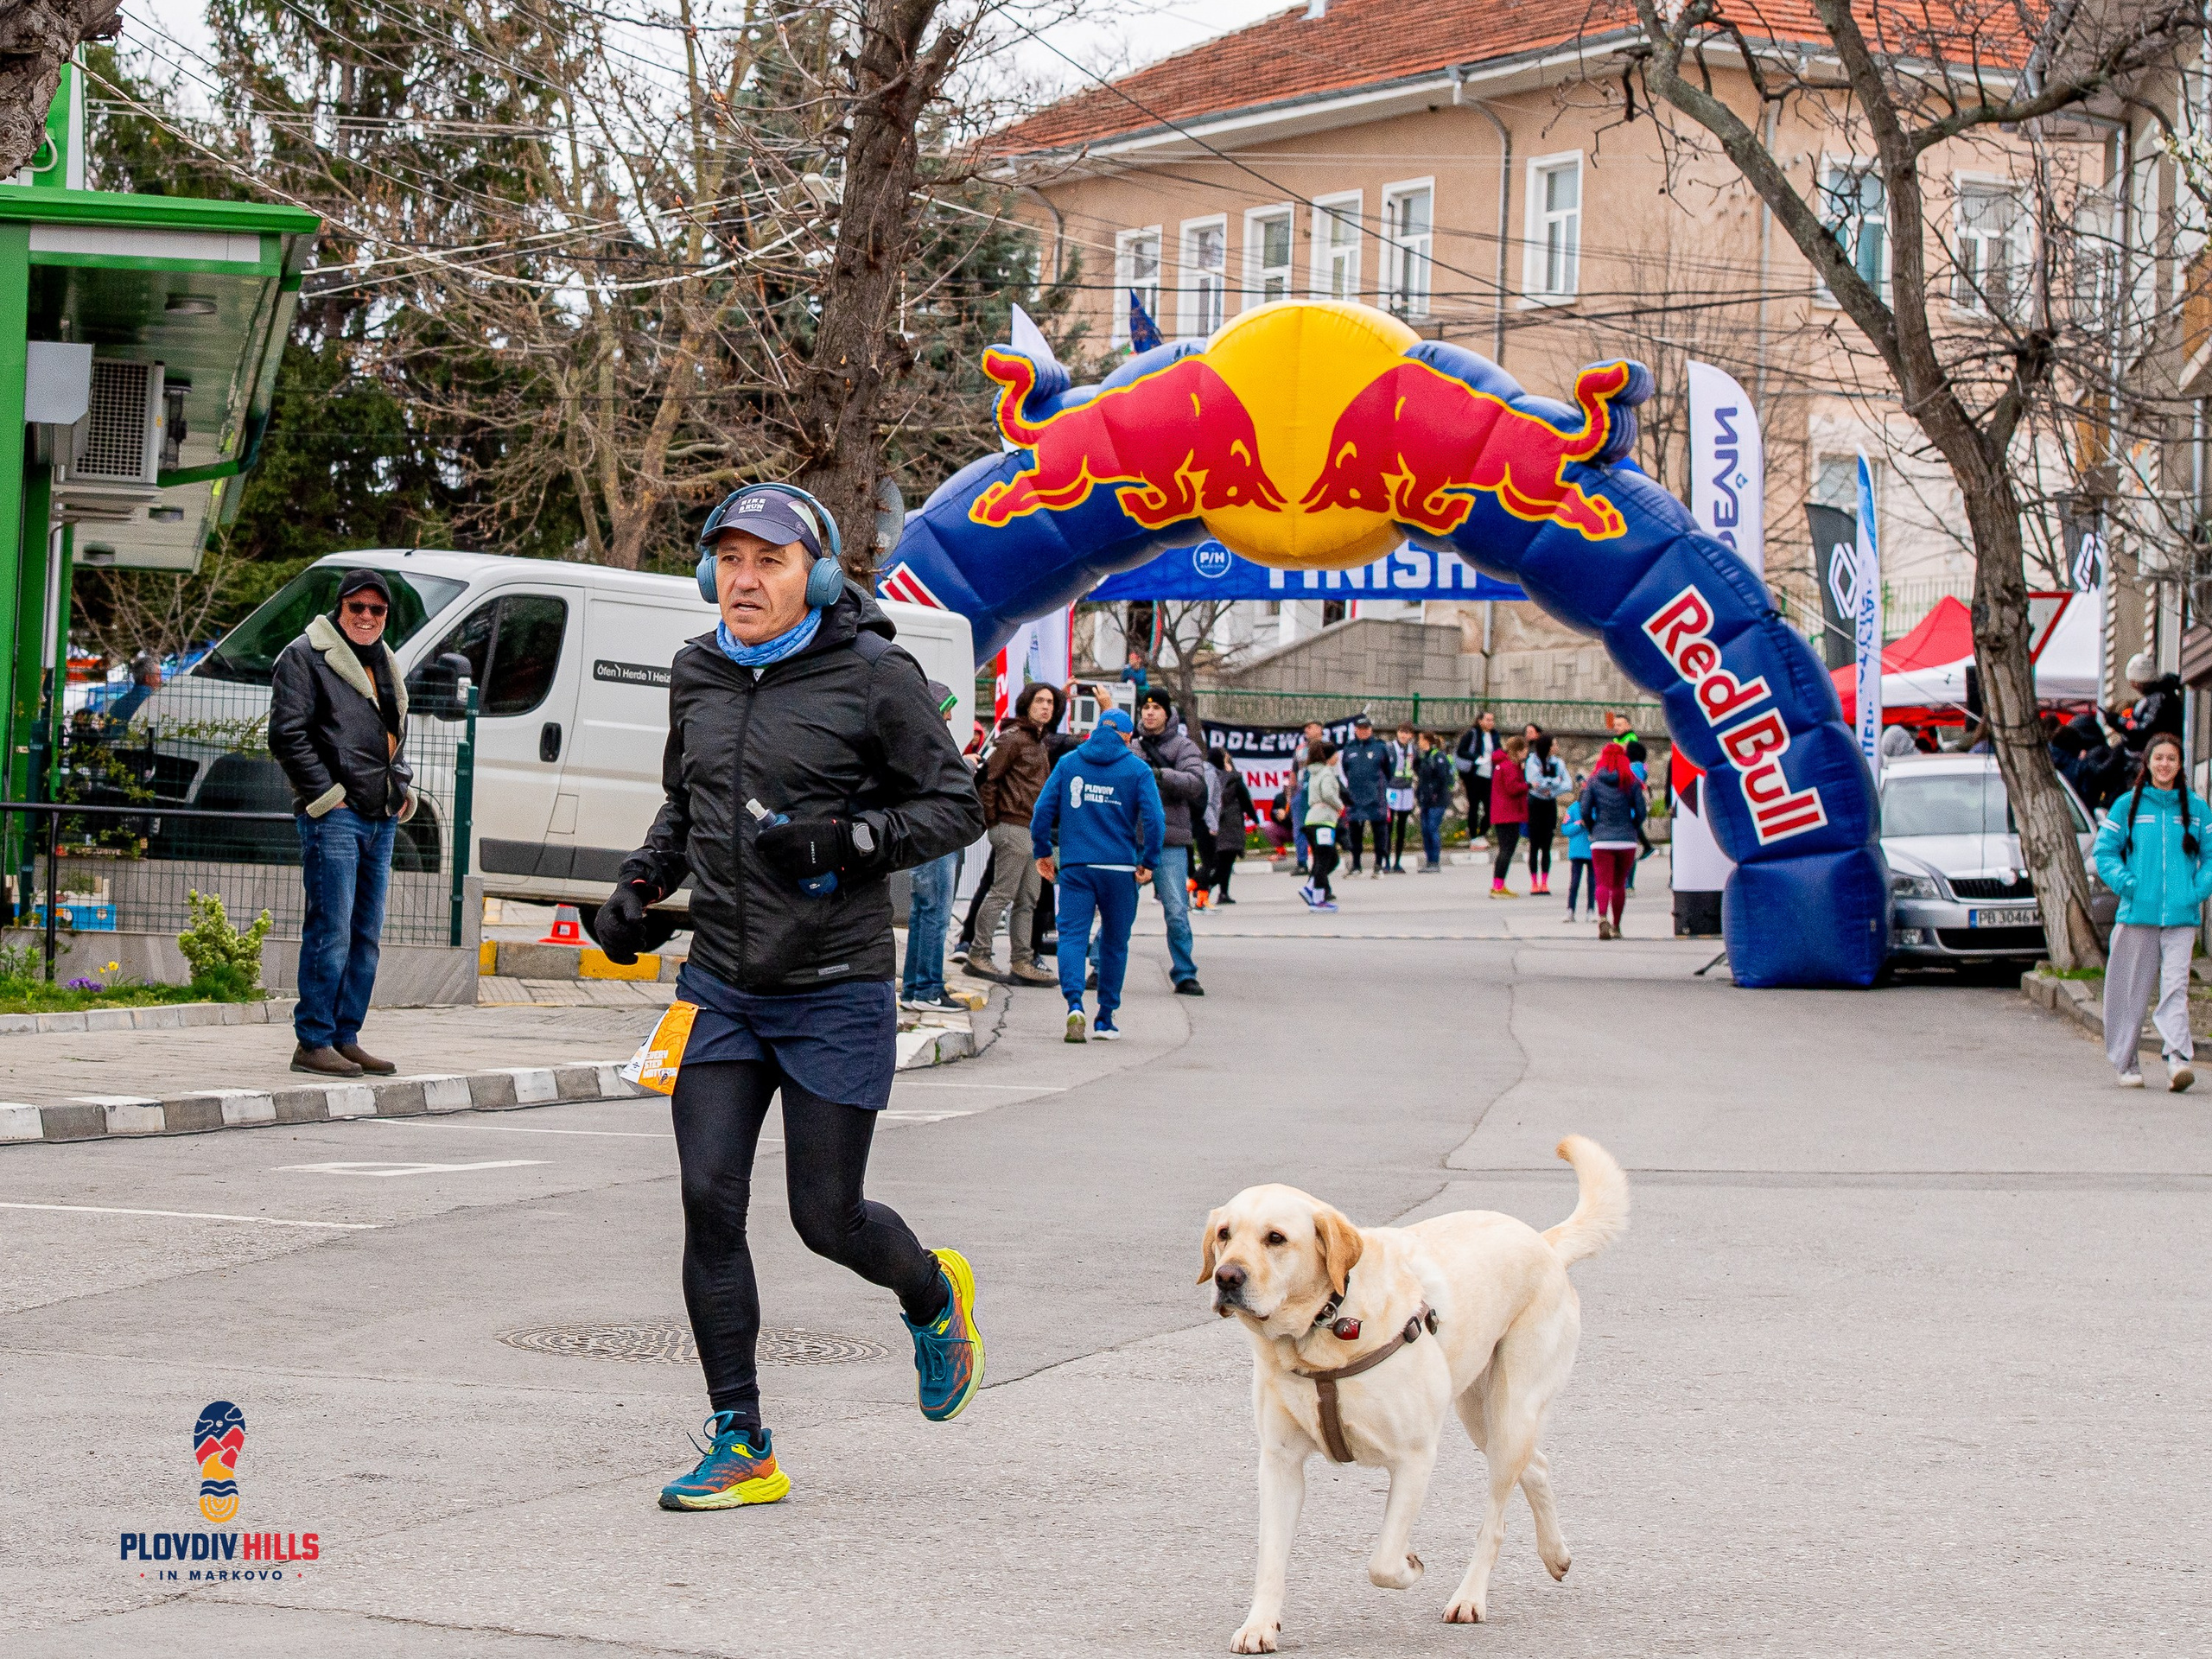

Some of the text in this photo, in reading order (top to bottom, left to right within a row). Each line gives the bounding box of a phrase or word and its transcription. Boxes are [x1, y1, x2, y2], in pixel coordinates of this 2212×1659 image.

[597, 664, 616, 677] Öfen
[622, 668, 646, 681] Herde
[1643, 585, 1827, 845] Red Bull
[1084, 784, 1115, 795] PLOVDIV
[1084, 793, 1104, 803] HILLS
[2002, 909, 2030, 923] 3046
